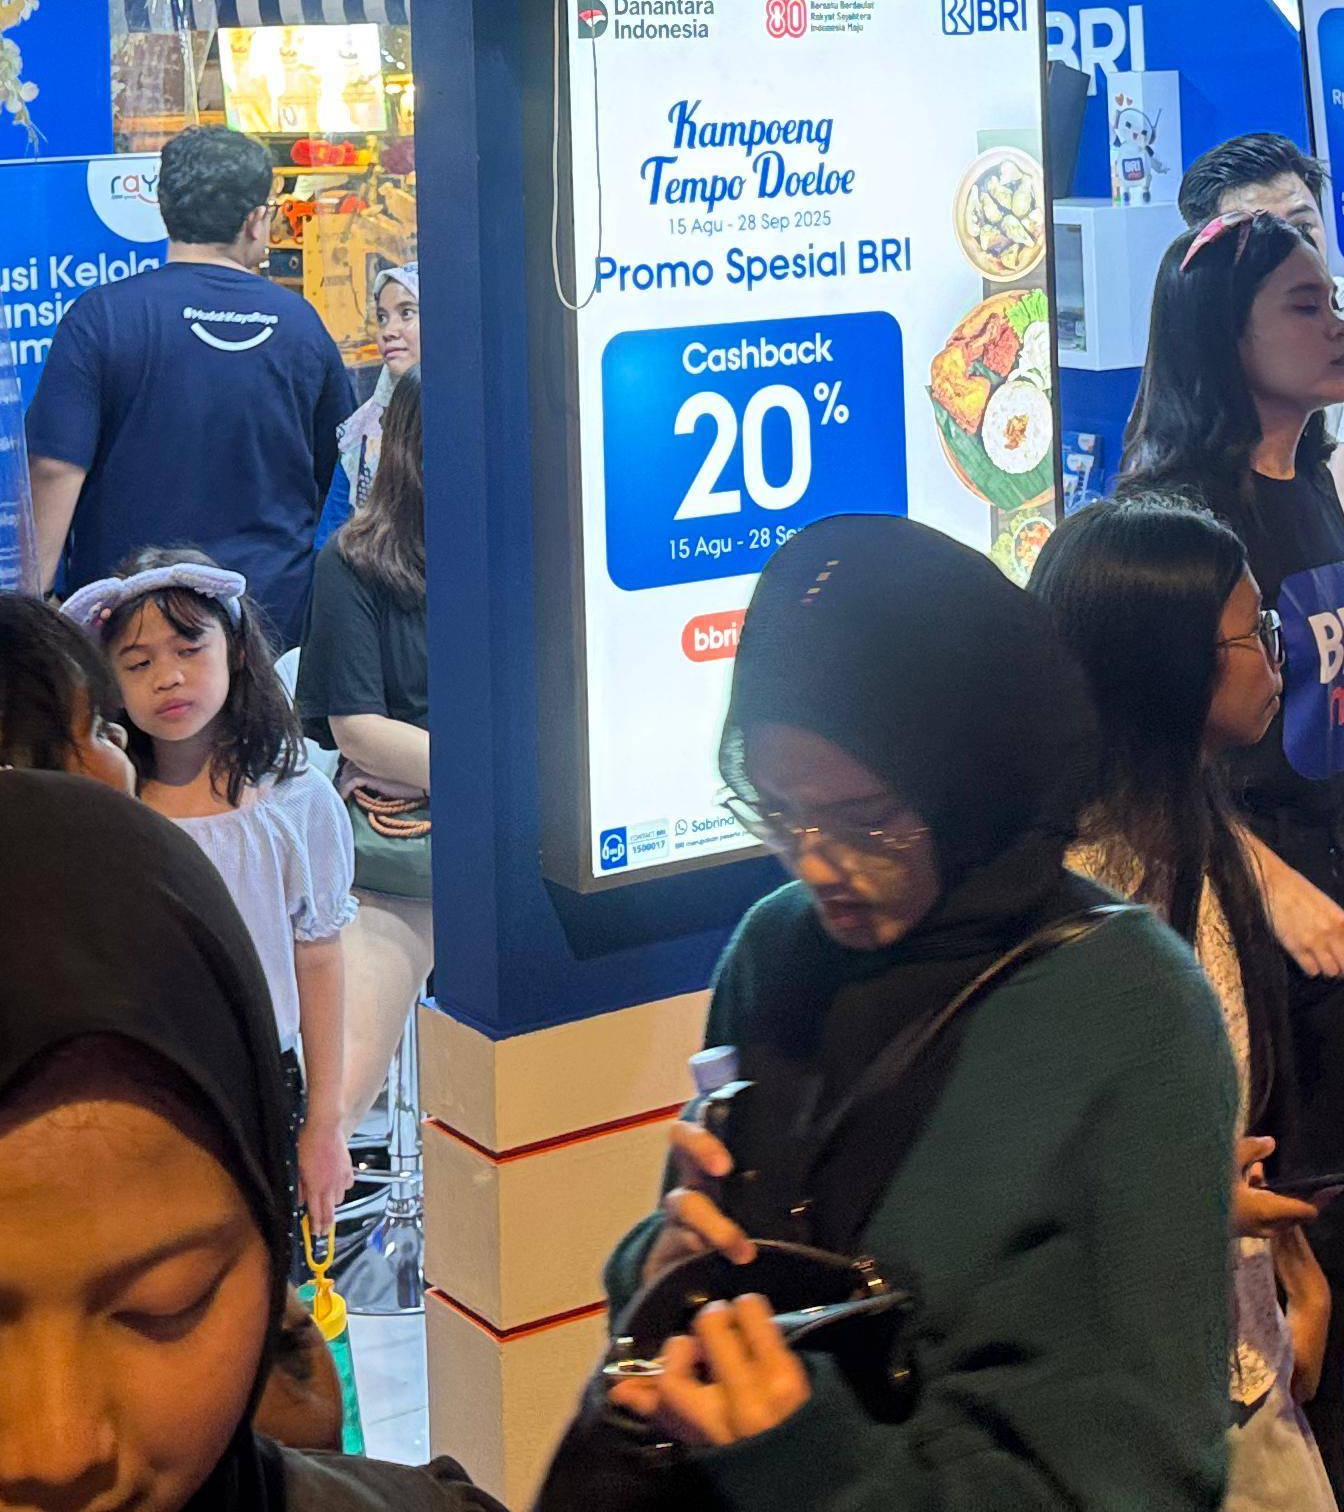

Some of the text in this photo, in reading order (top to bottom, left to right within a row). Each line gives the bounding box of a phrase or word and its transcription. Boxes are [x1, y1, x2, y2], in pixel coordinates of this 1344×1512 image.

[615, 19, 709, 40] Indonesia
[1046, 4, 1146, 96] BRI
[668, 99, 834, 155] Kampoeng
[111, 174, 158, 194] ray
[640, 150, 856, 213] Tempo Doeloe
[669, 209, 831, 238] 15 Agu 28 Sep 2025
[596, 237, 912, 294] Promo Spesial BRI
[682, 333, 833, 375] Cashback
[669, 525, 803, 560] 15 Agu 28 Se
[692, 816, 735, 833] Sabrina
